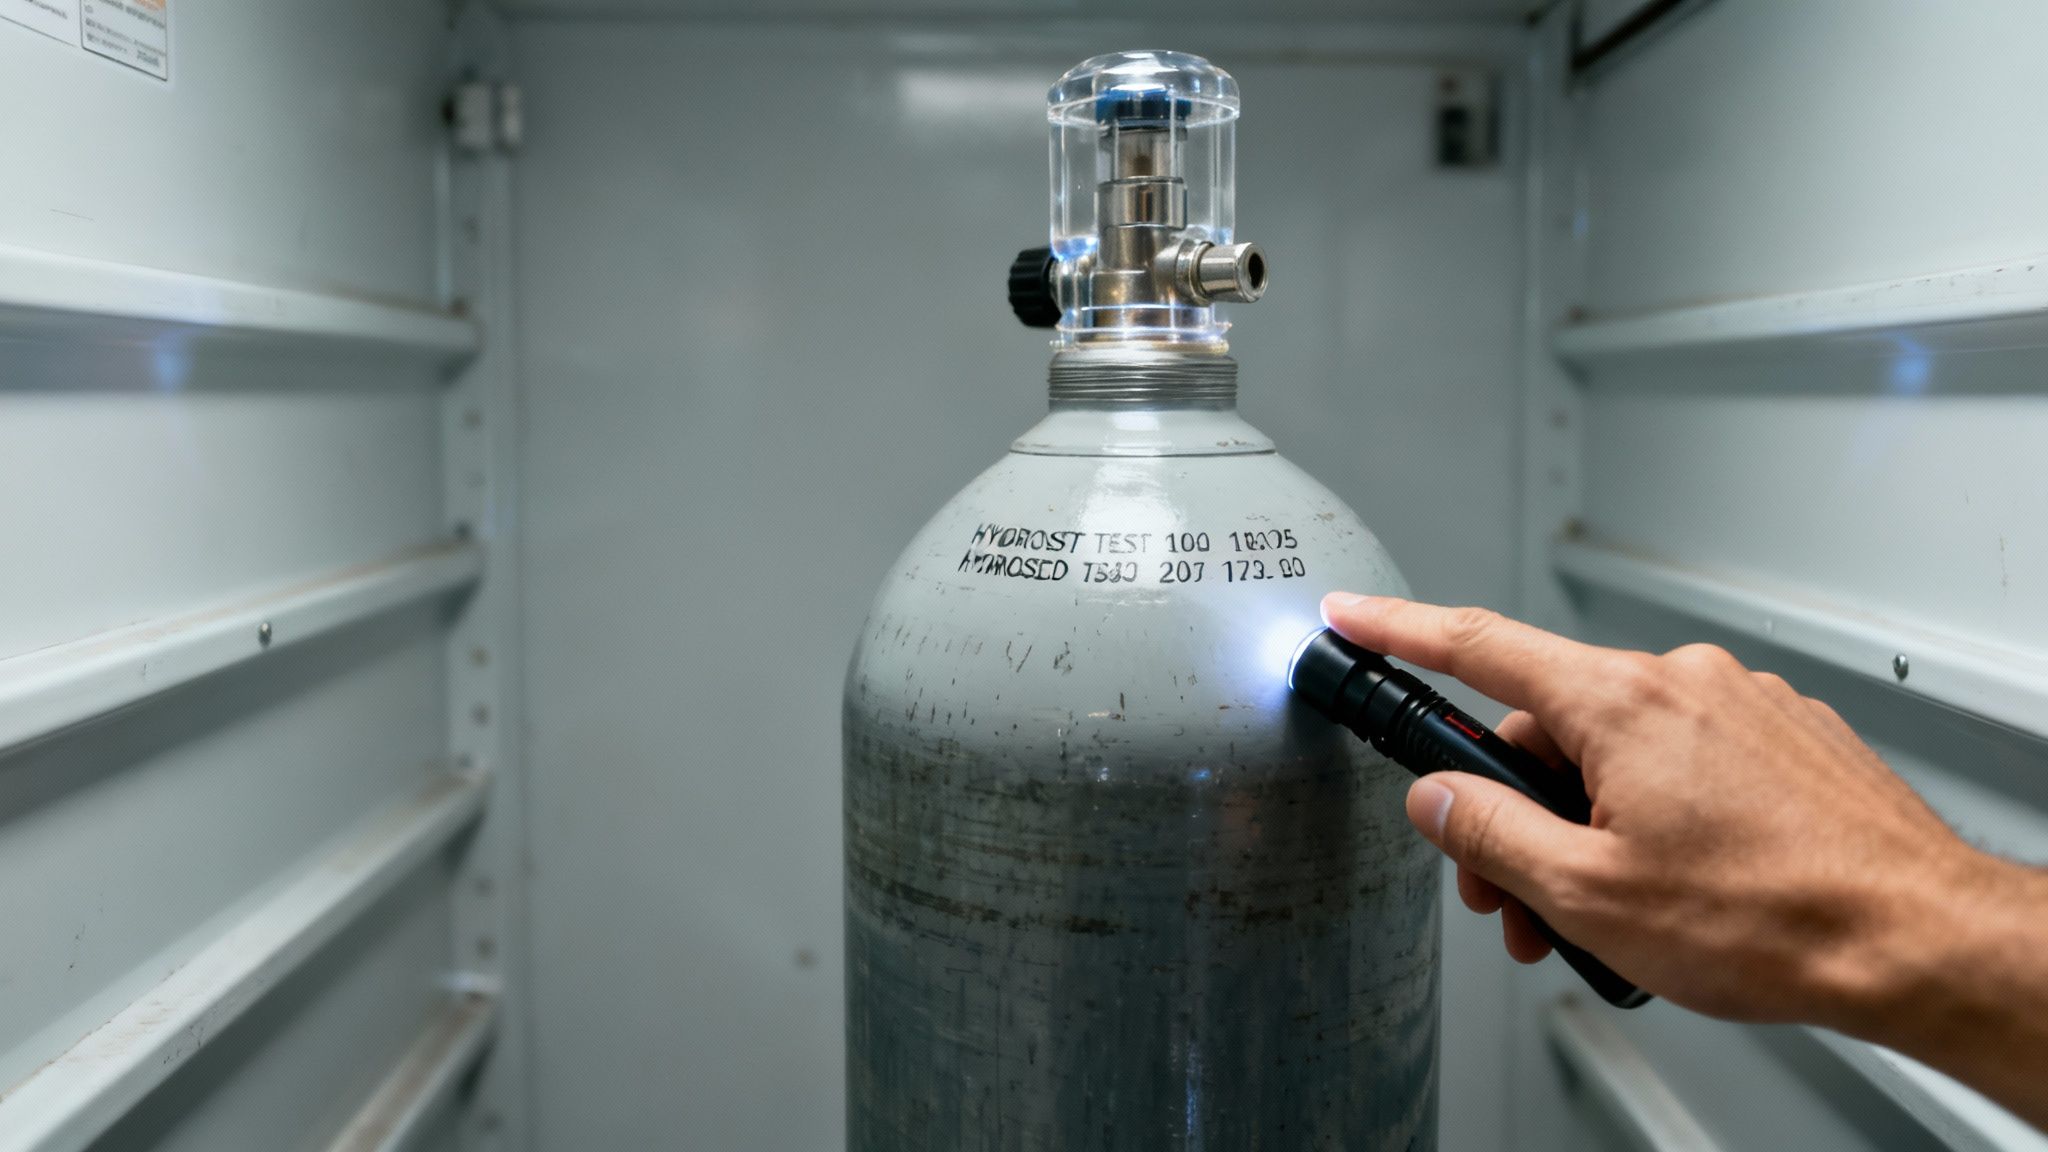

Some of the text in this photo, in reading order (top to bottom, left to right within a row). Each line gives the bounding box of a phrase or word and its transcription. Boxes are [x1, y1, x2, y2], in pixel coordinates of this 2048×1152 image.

[1094, 533, 1152, 553] TEST
[1166, 532, 1210, 553] 100
[1159, 560, 1205, 583] 207
